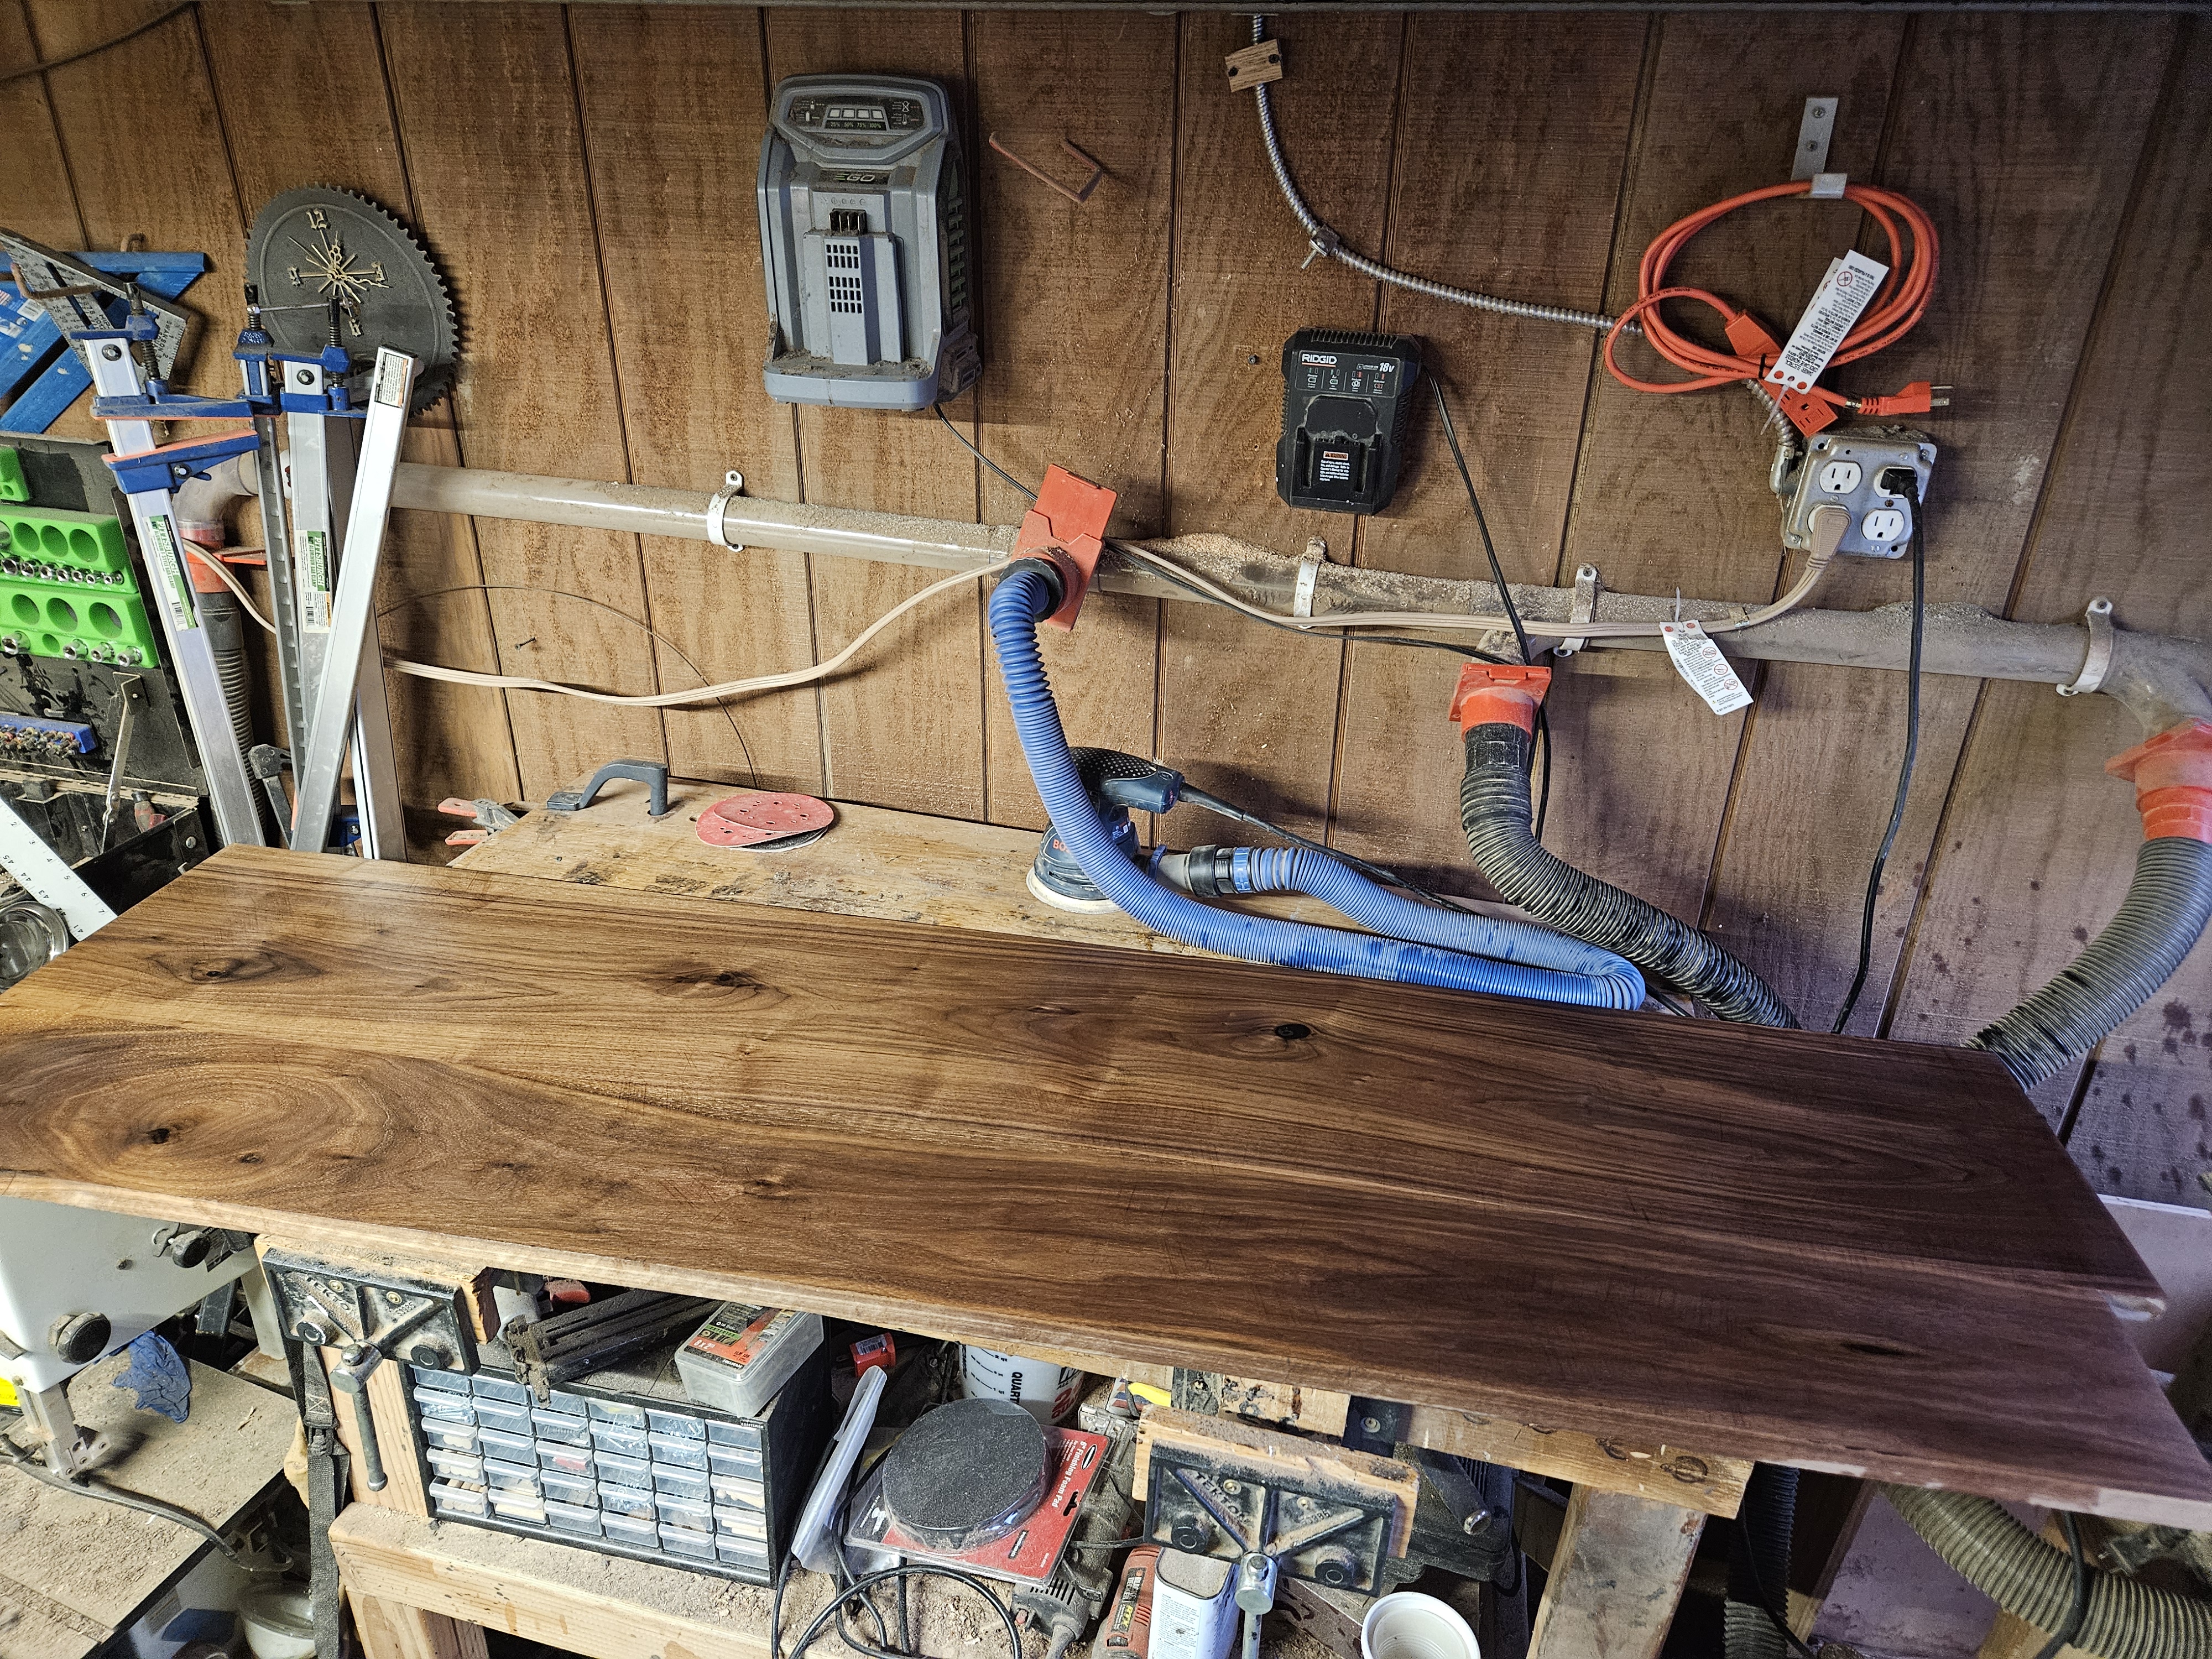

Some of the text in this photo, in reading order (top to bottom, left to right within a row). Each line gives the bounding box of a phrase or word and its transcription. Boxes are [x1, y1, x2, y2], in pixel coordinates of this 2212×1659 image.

[836, 173, 875, 182] EGO
[306, 208, 327, 230] 12
[1302, 353, 1338, 364] RIDGID
[154, 531, 163, 552] ALUMINUM
[156, 520, 180, 576] PITTSBURGH
[314, 536, 325, 587] PITTSBURGH
[20, 872, 32, 881] 44
[38, 890, 50, 900] 43
[1065, 1448, 1083, 1477] Finishing
[1058, 1477, 1071, 1495] Foam
[1052, 1495, 1063, 1508] Pad
[1123, 1577, 1135, 1601] DECKER
